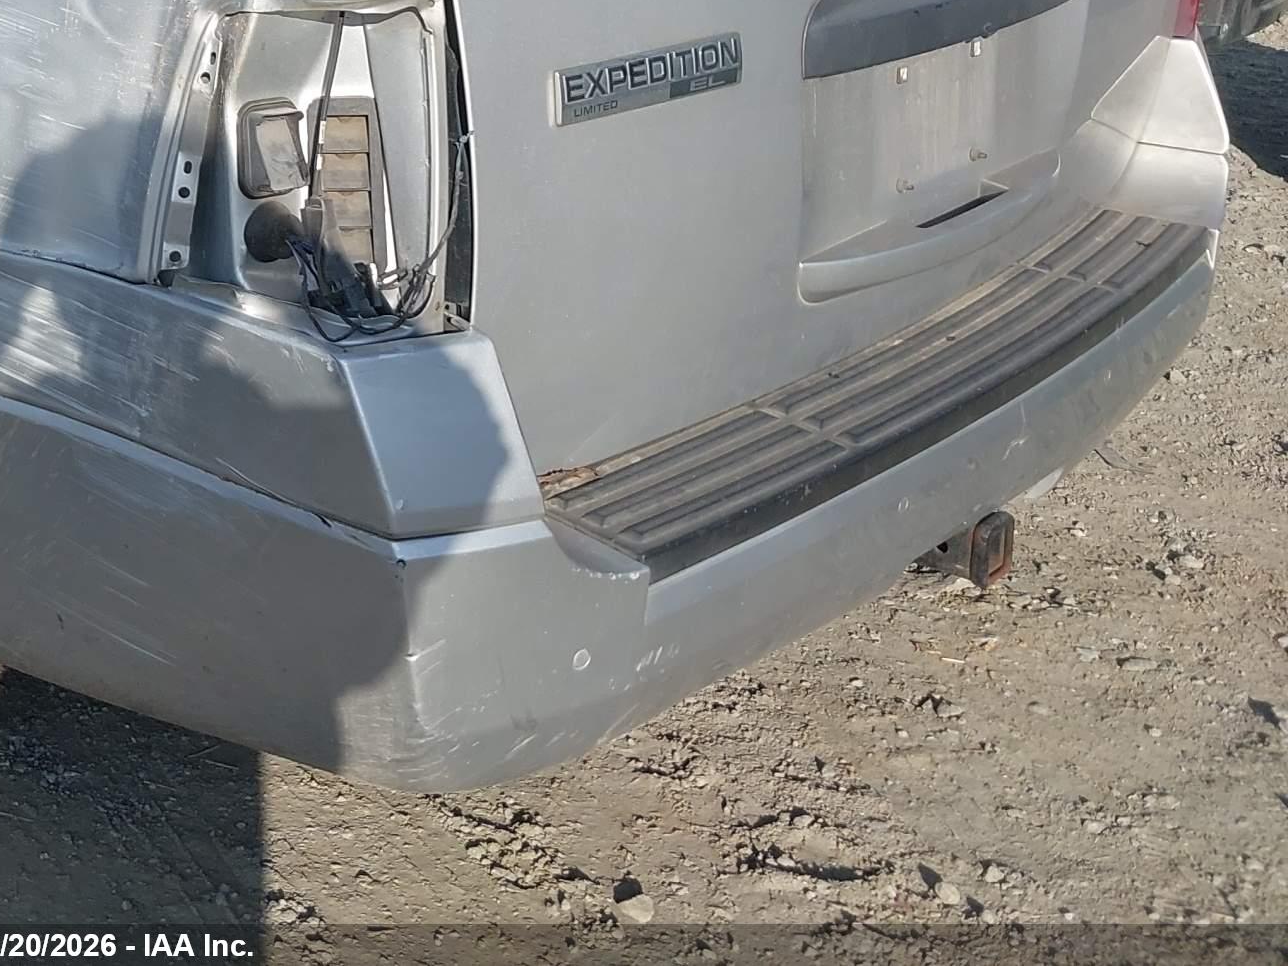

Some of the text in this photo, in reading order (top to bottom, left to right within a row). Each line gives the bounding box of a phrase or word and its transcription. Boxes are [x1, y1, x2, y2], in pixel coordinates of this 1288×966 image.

[563, 39, 739, 103] EXPEDITION
[690, 77, 726, 92] EL
[573, 99, 618, 118] LIMITED
